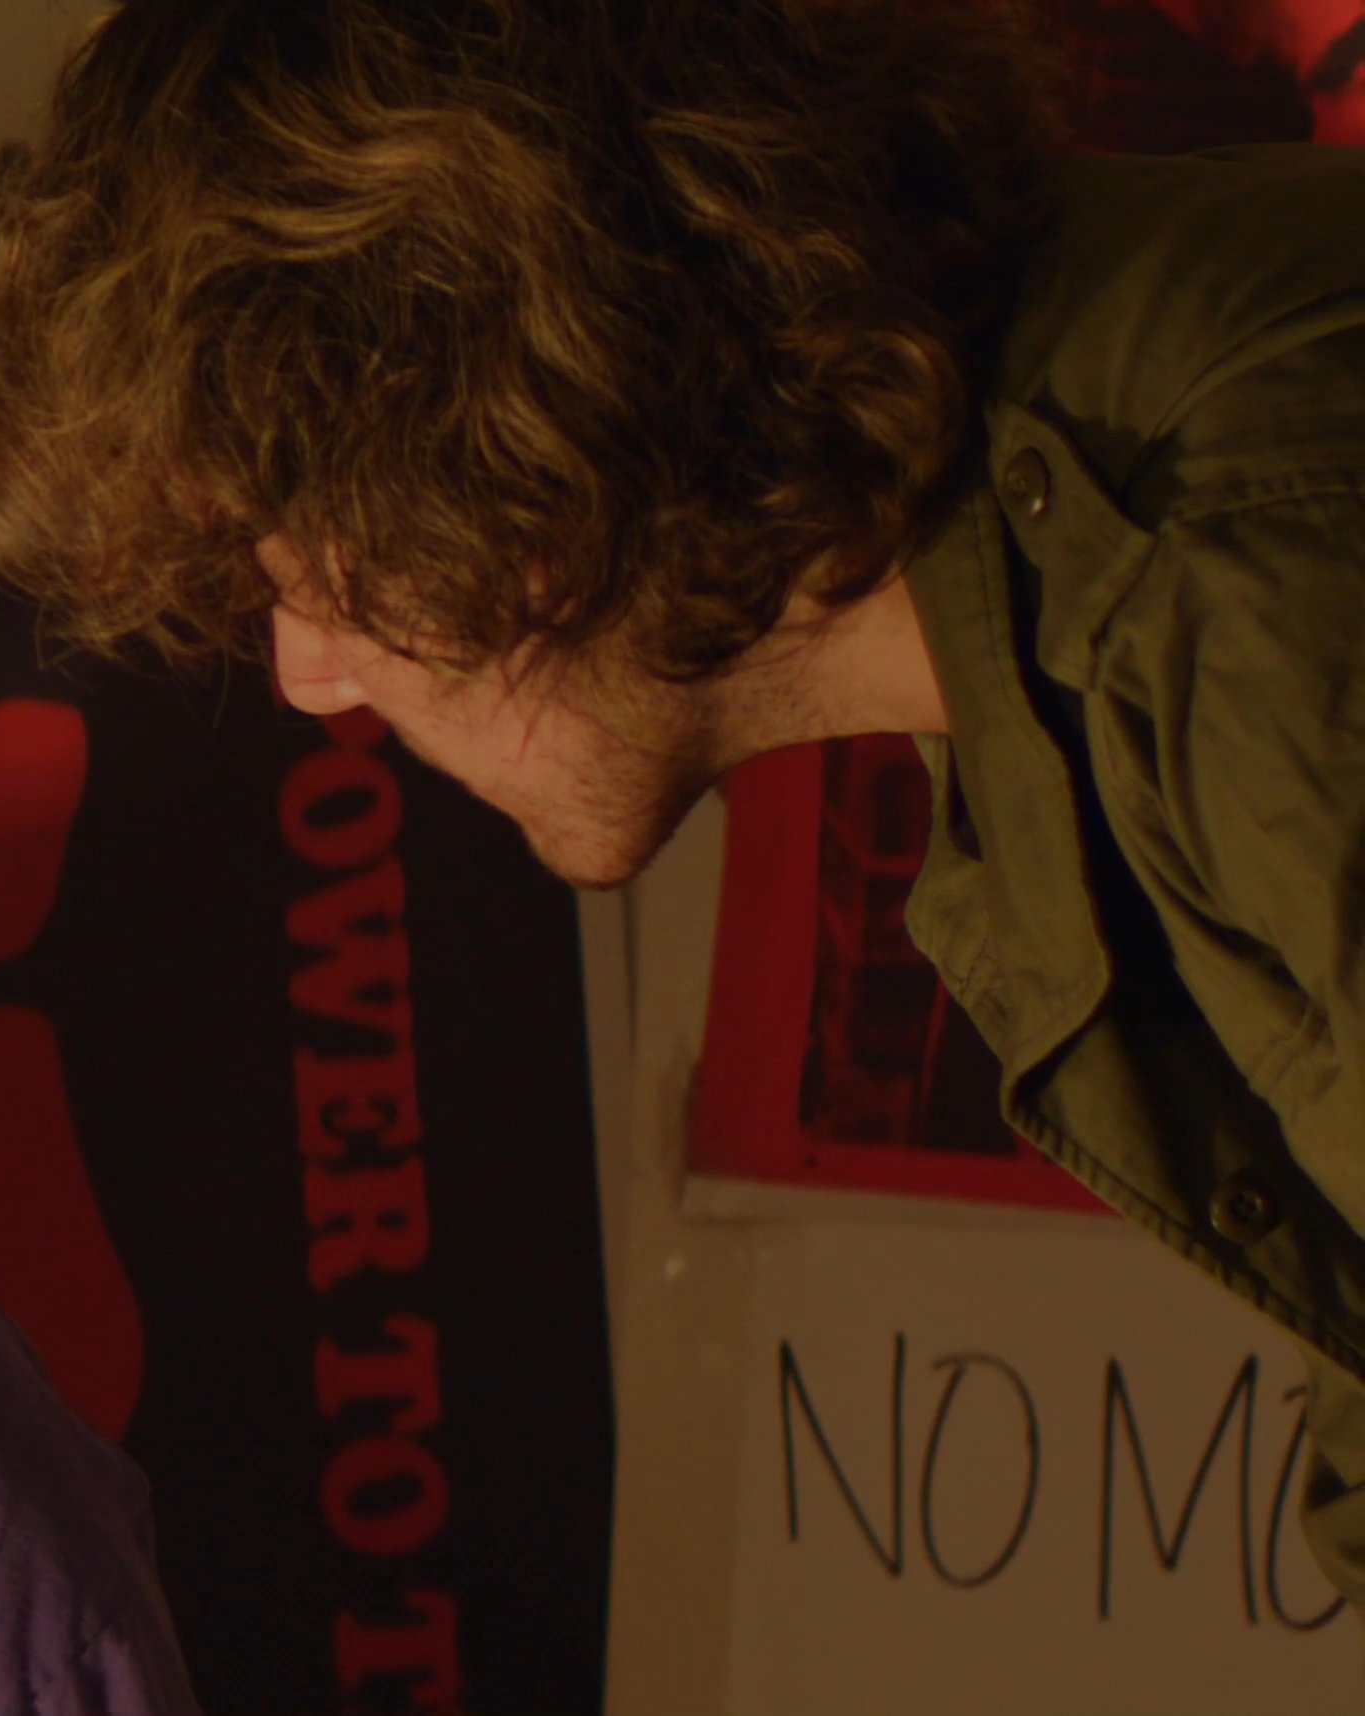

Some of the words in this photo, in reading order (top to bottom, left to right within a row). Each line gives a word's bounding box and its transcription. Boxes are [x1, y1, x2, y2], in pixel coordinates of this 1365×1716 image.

[279, 704, 432, 1296] OWER
[313, 1310, 451, 1556] TO
[778, 1330, 1039, 1590] NO
